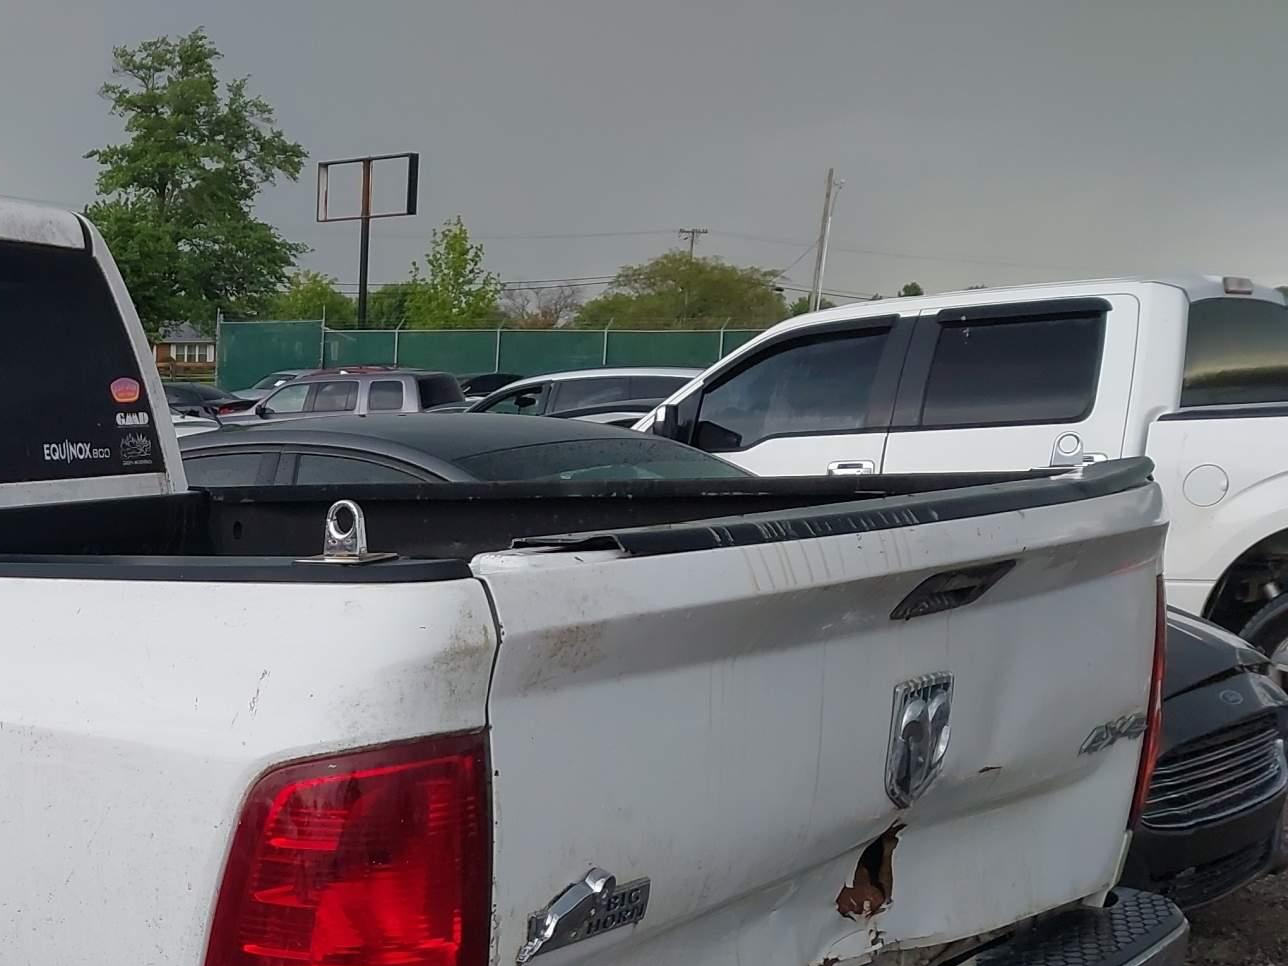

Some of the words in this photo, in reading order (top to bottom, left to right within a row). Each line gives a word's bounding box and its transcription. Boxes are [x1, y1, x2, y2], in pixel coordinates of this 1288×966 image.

[43, 440, 92, 464] EQUINOX
[606, 888, 641, 911] BIG
[586, 902, 646, 935] HORN
